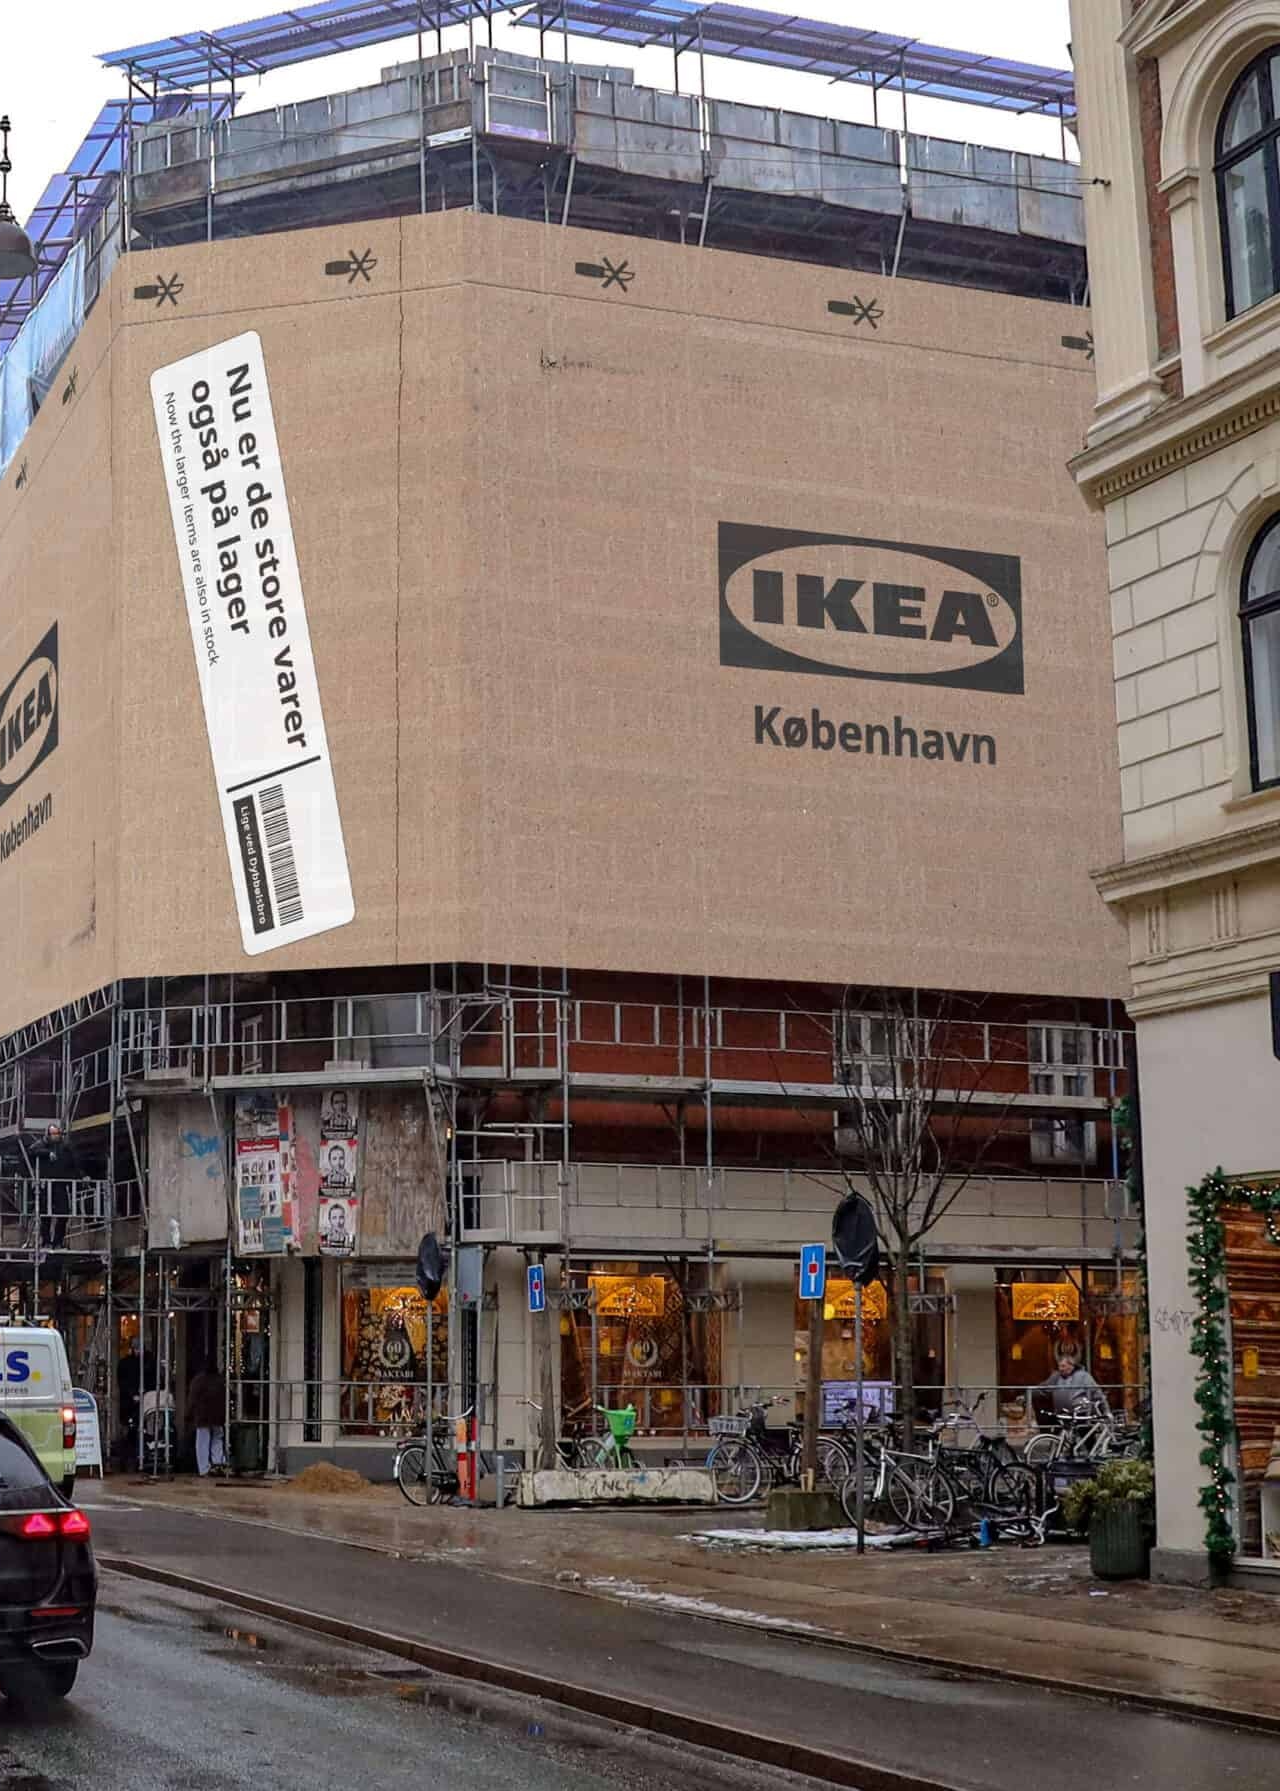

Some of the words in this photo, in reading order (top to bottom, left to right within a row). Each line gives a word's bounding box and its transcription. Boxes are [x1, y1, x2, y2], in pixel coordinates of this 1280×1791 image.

[163, 392, 177, 426] Now
[226, 363, 253, 422] Nu
[171, 428, 183, 454] the
[188, 380, 229, 471] også
[238, 432, 261, 470] er
[175, 456, 191, 500] larger
[183, 503, 198, 547] items
[200, 480, 239, 529] på
[245, 482, 273, 530] de
[190, 550, 202, 574] are
[195, 576, 208, 607] also
[216, 535, 250, 635] lager
[255, 538, 287, 639] store
[200, 608, 211, 624] in
[752, 568, 1000, 648] IKEA
[203, 627, 220, 667] stock
[274, 645, 307, 748] varer
[753, 704, 997, 765] København
[0, 792, 53, 865] København
[240, 805, 251, 832] Lige
[245, 833, 257, 856] ved
